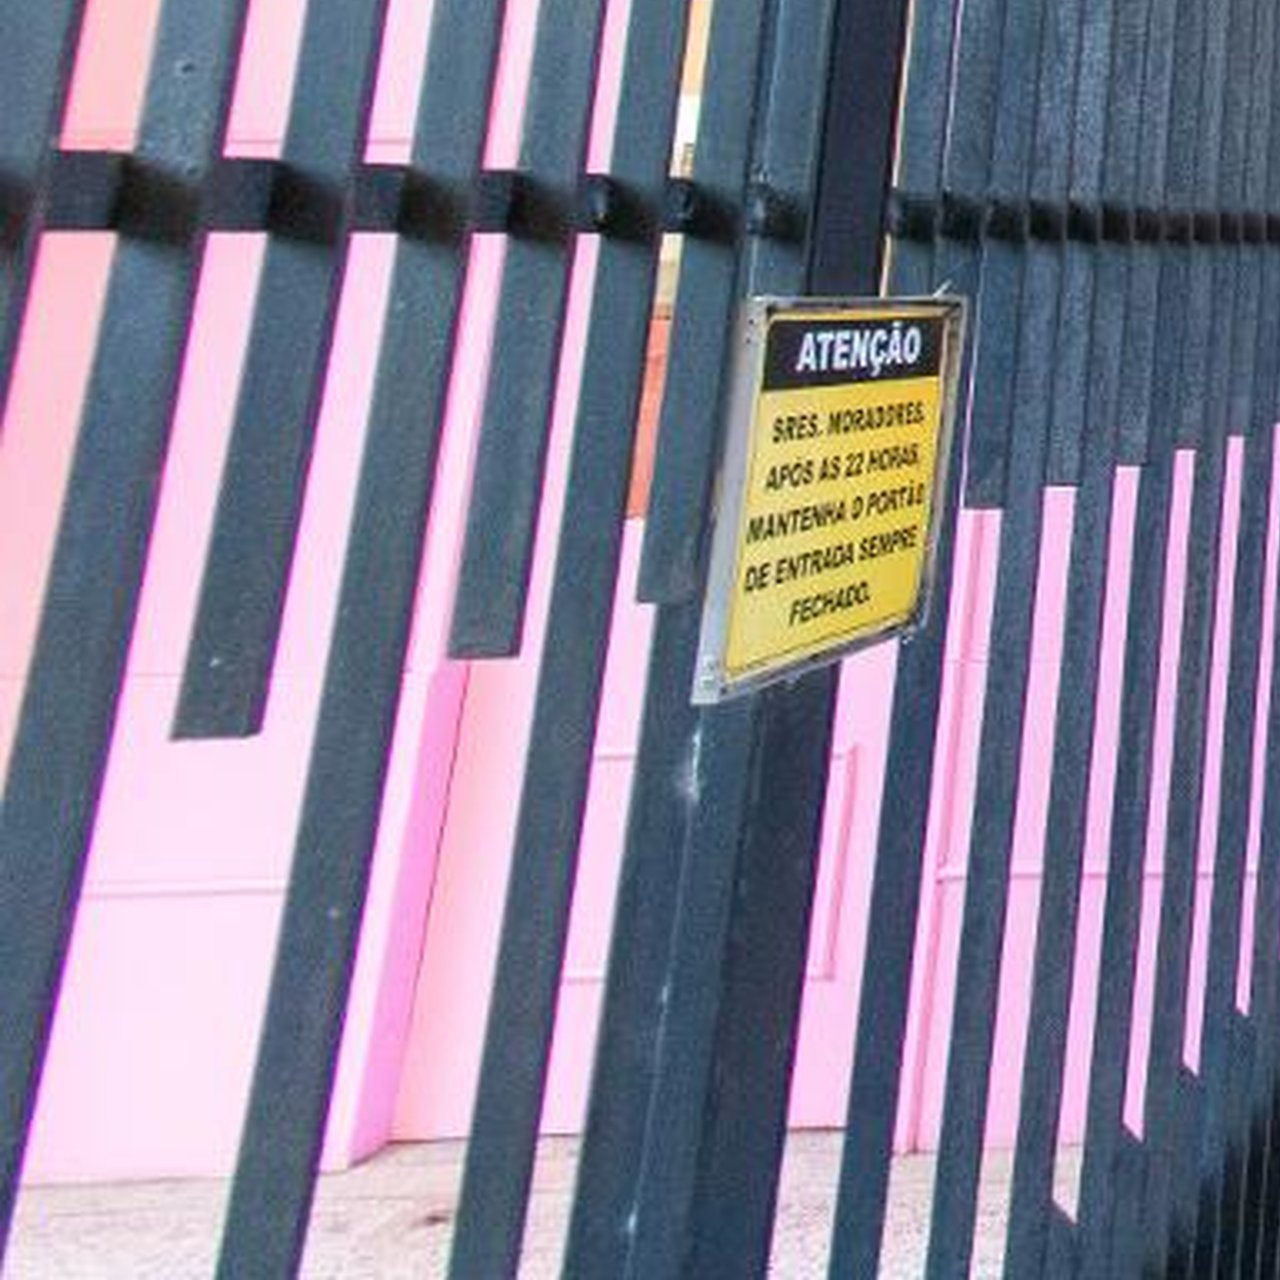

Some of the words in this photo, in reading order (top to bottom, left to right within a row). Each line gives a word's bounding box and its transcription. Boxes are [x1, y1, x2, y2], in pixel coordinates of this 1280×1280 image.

[795, 321, 923, 377] ATENÇÃO
[843, 452, 865, 479] 22
[746, 500, 847, 544] MANTENHA
[850, 495, 864, 521] O
[744, 561, 771, 592] DE
[775, 542, 854, 585] ENTRADA
[858, 524, 919, 561] SEMPRE
